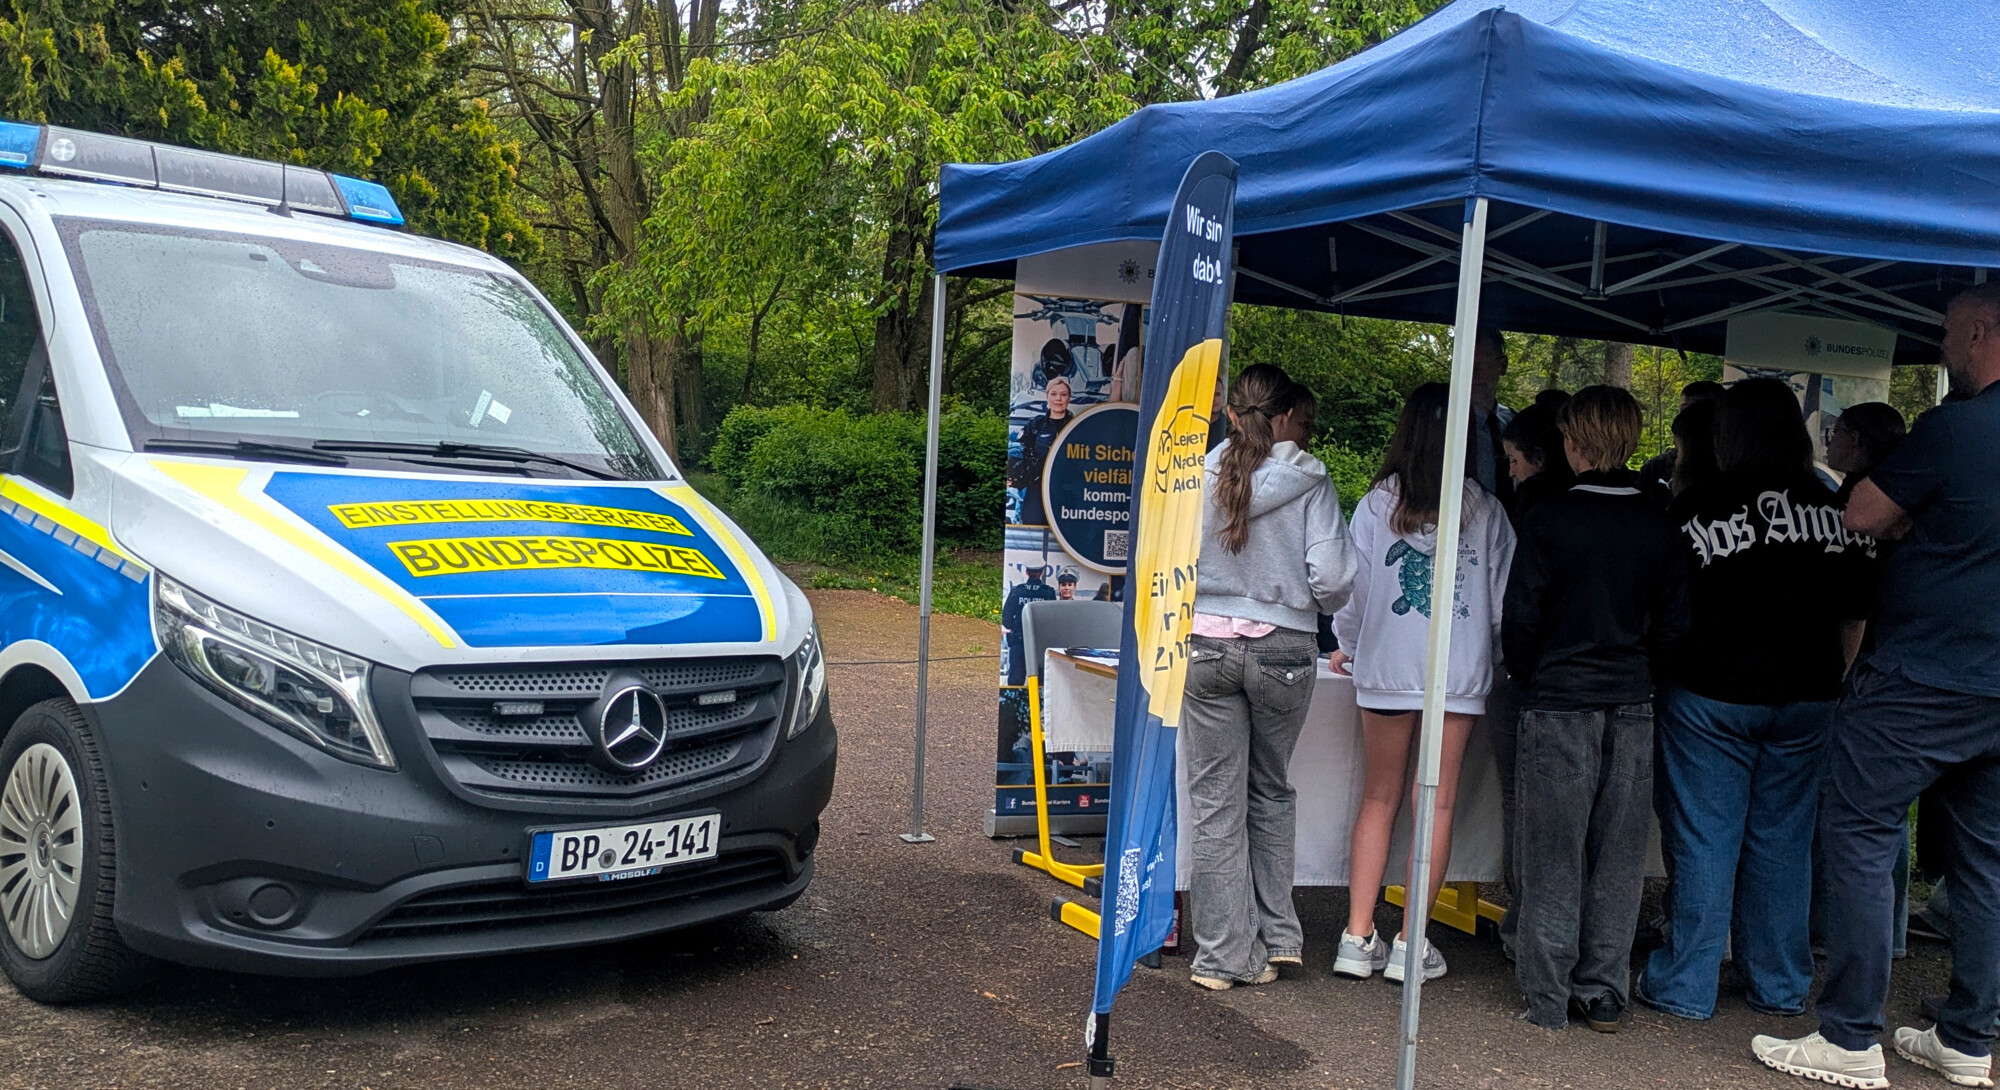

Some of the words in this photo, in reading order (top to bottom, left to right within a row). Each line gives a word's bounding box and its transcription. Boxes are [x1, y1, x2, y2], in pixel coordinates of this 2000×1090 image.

[1186, 203, 1205, 237] Wir
[1826, 343, 1889, 359] BUNDESPOLIZEI
[1066, 443, 1091, 460] Mit
[1083, 487, 1131, 503] komm-
[337, 502, 687, 535] EINSTELLUNGSBERATER
[1061, 505, 1130, 525] bundespo
[395, 539, 719, 577] BUNDESPOLIZEI
[561, 834, 600, 872] BP
[620, 819, 711, 866] 24-141
[535, 862, 544, 872] D
[610, 868, 653, 882] MOSOLF
